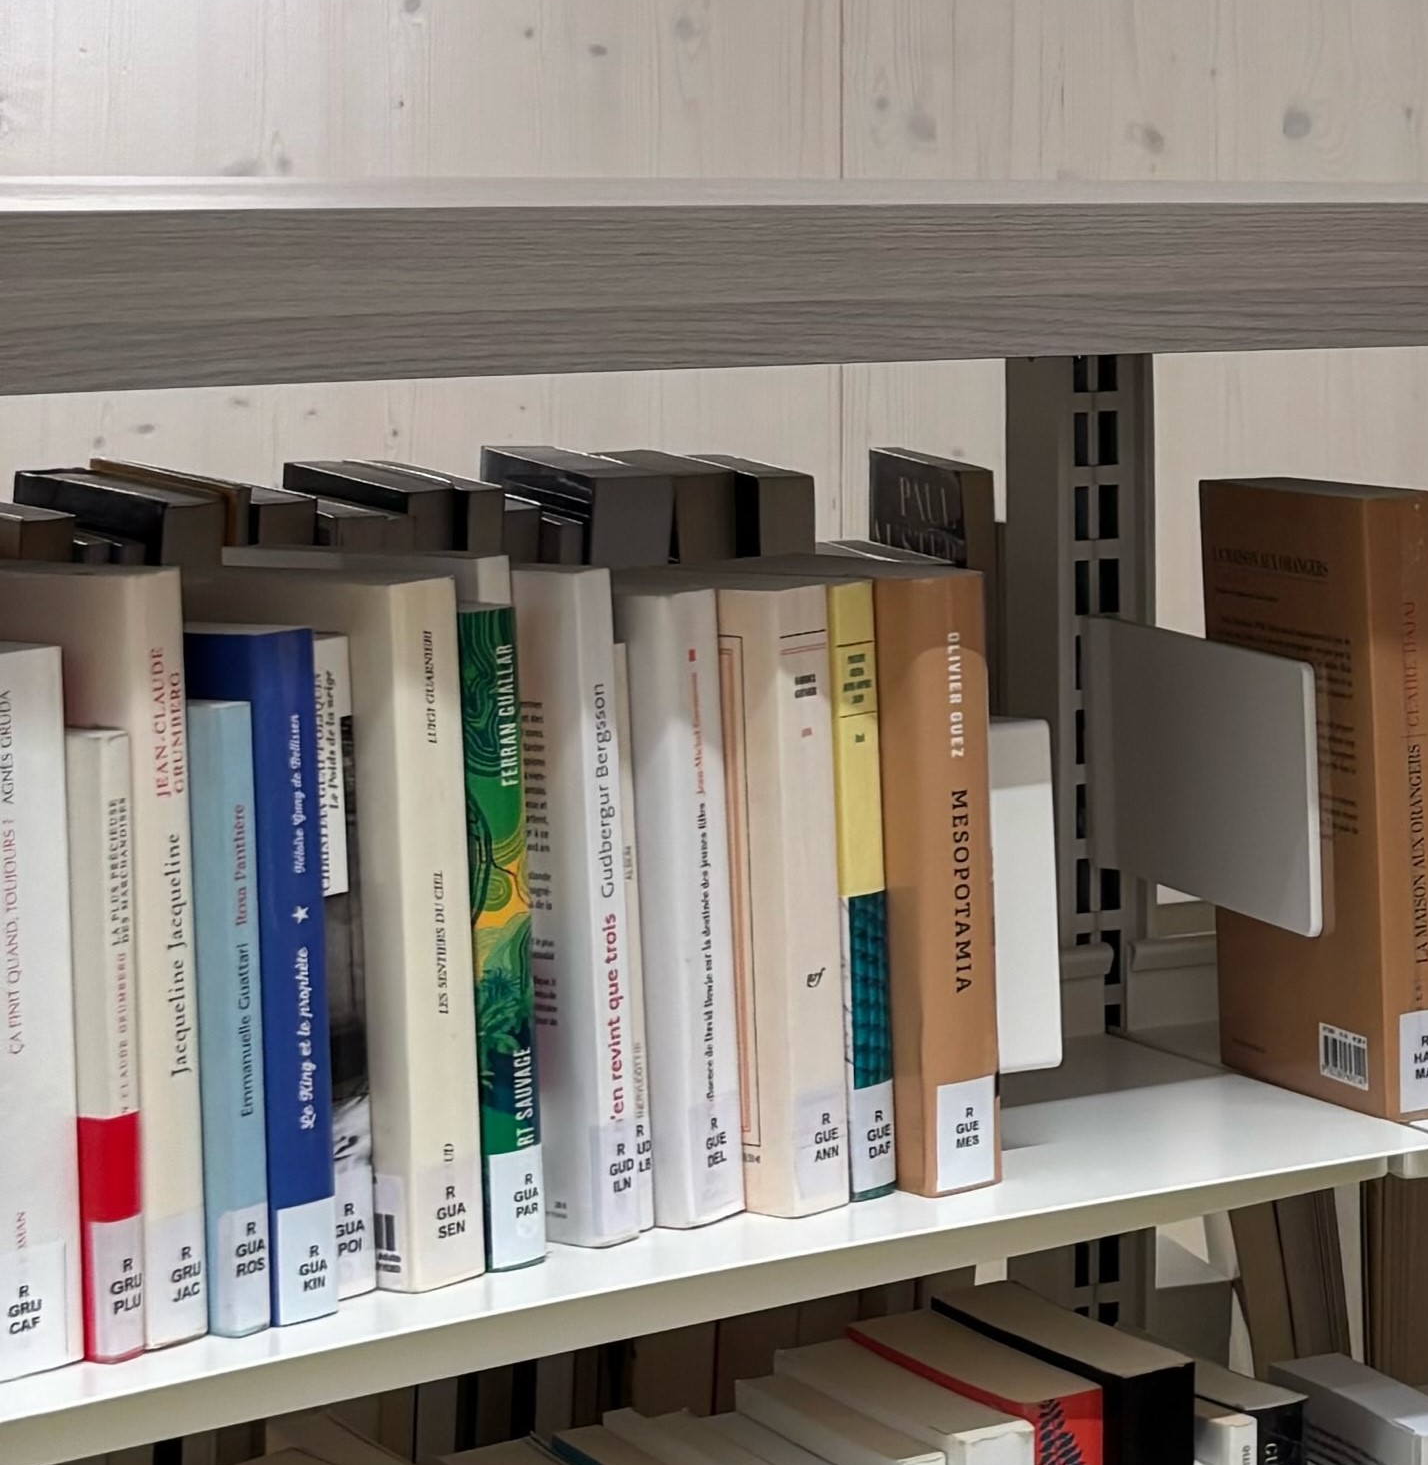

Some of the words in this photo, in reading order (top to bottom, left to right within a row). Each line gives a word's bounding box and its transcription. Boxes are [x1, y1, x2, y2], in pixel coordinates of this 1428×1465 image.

[495, 643, 516, 716] GUALLAR
[947, 632, 964, 703] OLIVIER
[150, 647, 172, 797] JEAN-CLAUDE
[168, 672, 185, 793] GRUMBERG
[499, 722, 520, 785] FERRAN
[591, 683, 611, 778] Bergsson
[596, 784, 615, 899] Gudbergur
[164, 834, 187, 949] Jacqueline
[951, 790, 972, 993] MESOPOTAMIA
[235, 942, 251, 1009] Guattari
[601, 914, 619, 964] trois
[169, 959, 192, 1077] Jacqueline
[605, 969, 625, 1011] que
[237, 1015, 254, 1117] Emmanuelle
[513, 1047, 534, 1120] SAUVAGE
[605, 1015, 623, 1080] revint
[956, 1120, 980, 1136] GUE
[956, 1135, 980, 1150] MES
